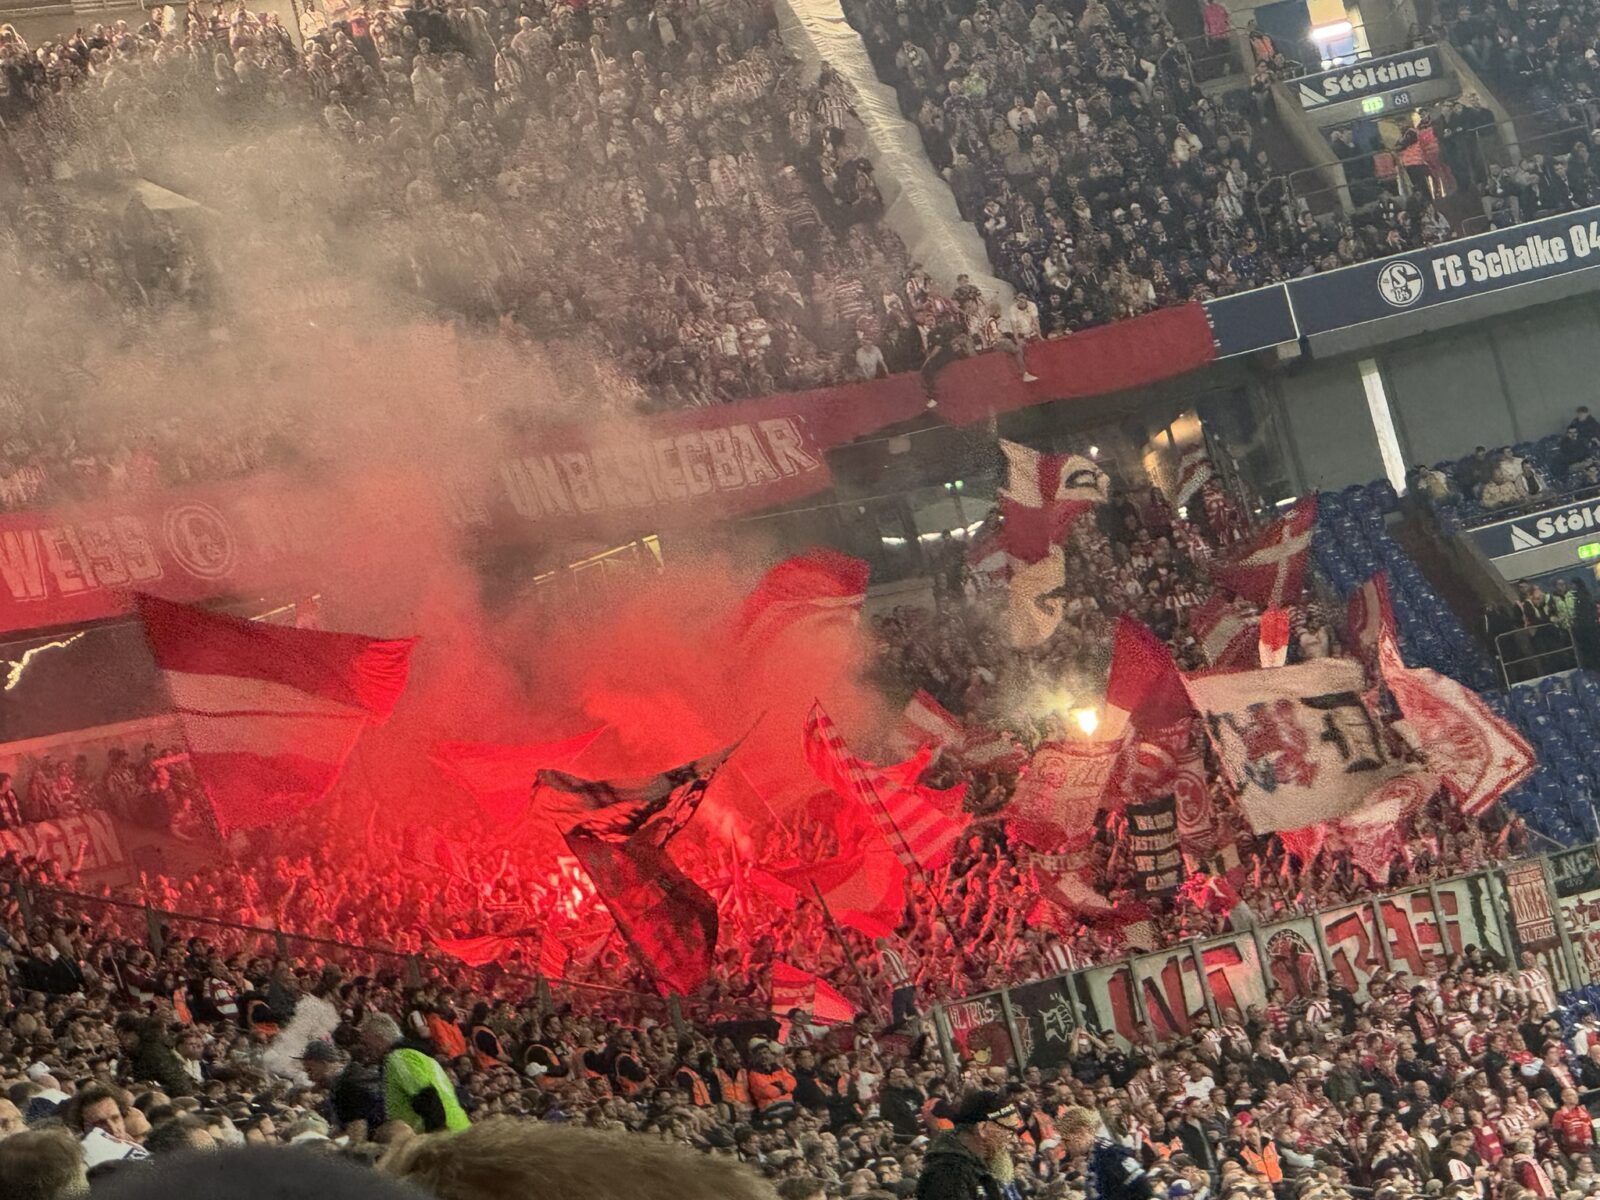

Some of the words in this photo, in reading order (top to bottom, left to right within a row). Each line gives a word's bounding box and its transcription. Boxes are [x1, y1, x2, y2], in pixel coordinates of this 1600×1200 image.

[1323, 57, 1432, 96] Stölting
[1394, 93, 1410, 105] 68
[1432, 254, 1467, 291] FC
[1467, 235, 1569, 282] Schalke
[0, 516, 164, 601] WEISS
